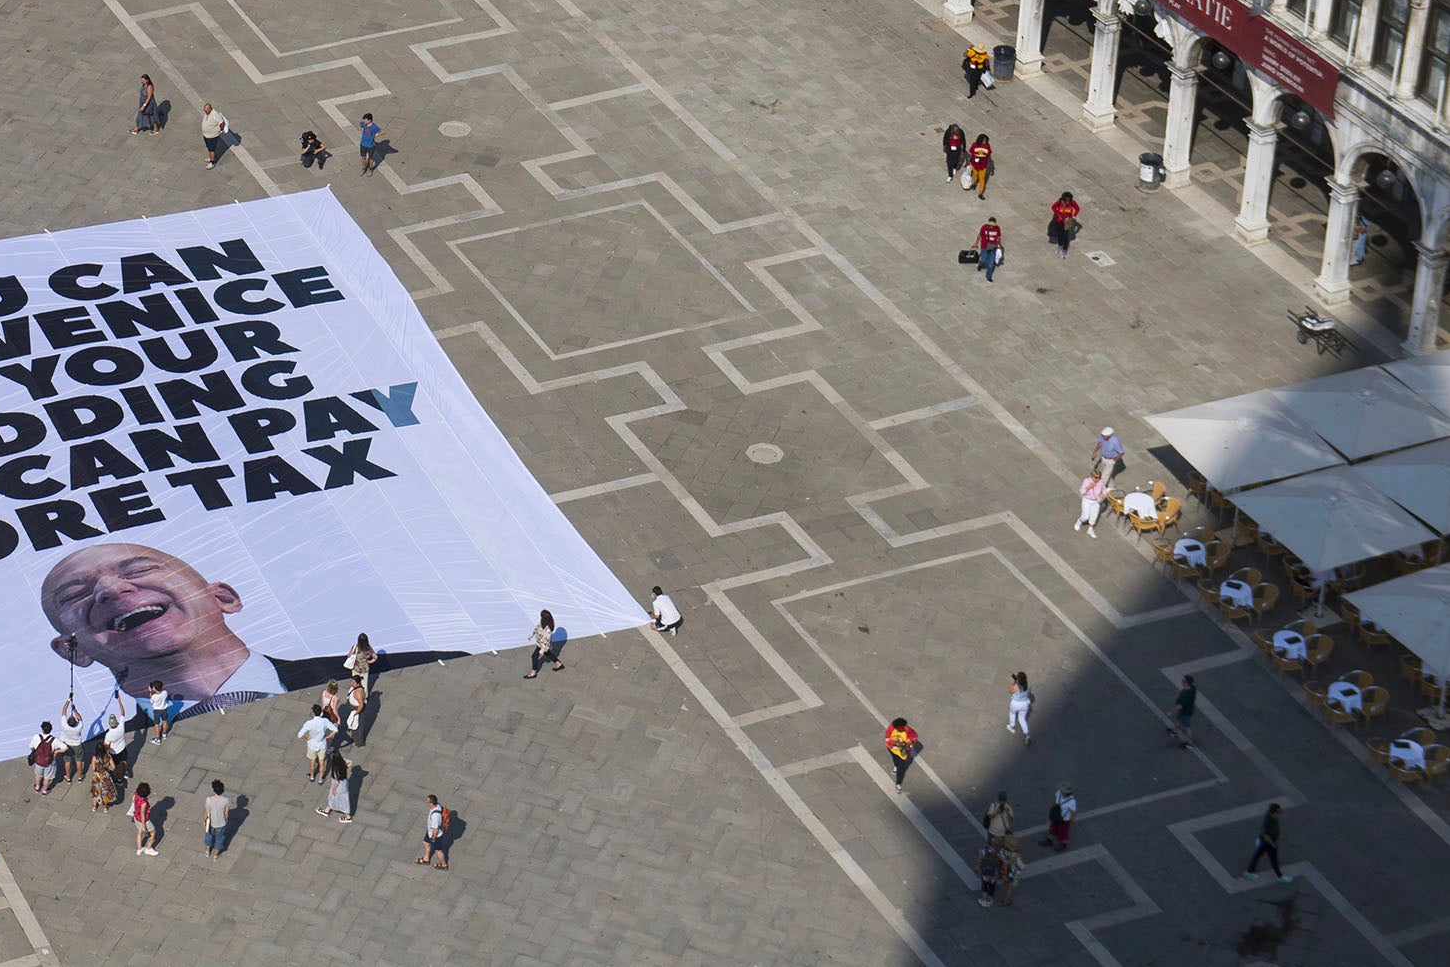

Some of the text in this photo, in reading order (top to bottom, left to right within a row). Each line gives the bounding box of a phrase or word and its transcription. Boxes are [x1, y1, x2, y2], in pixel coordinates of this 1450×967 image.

[48, 239, 265, 301] CAN
[227, 382, 419, 454] PAY
[165, 437, 398, 511] TAX
